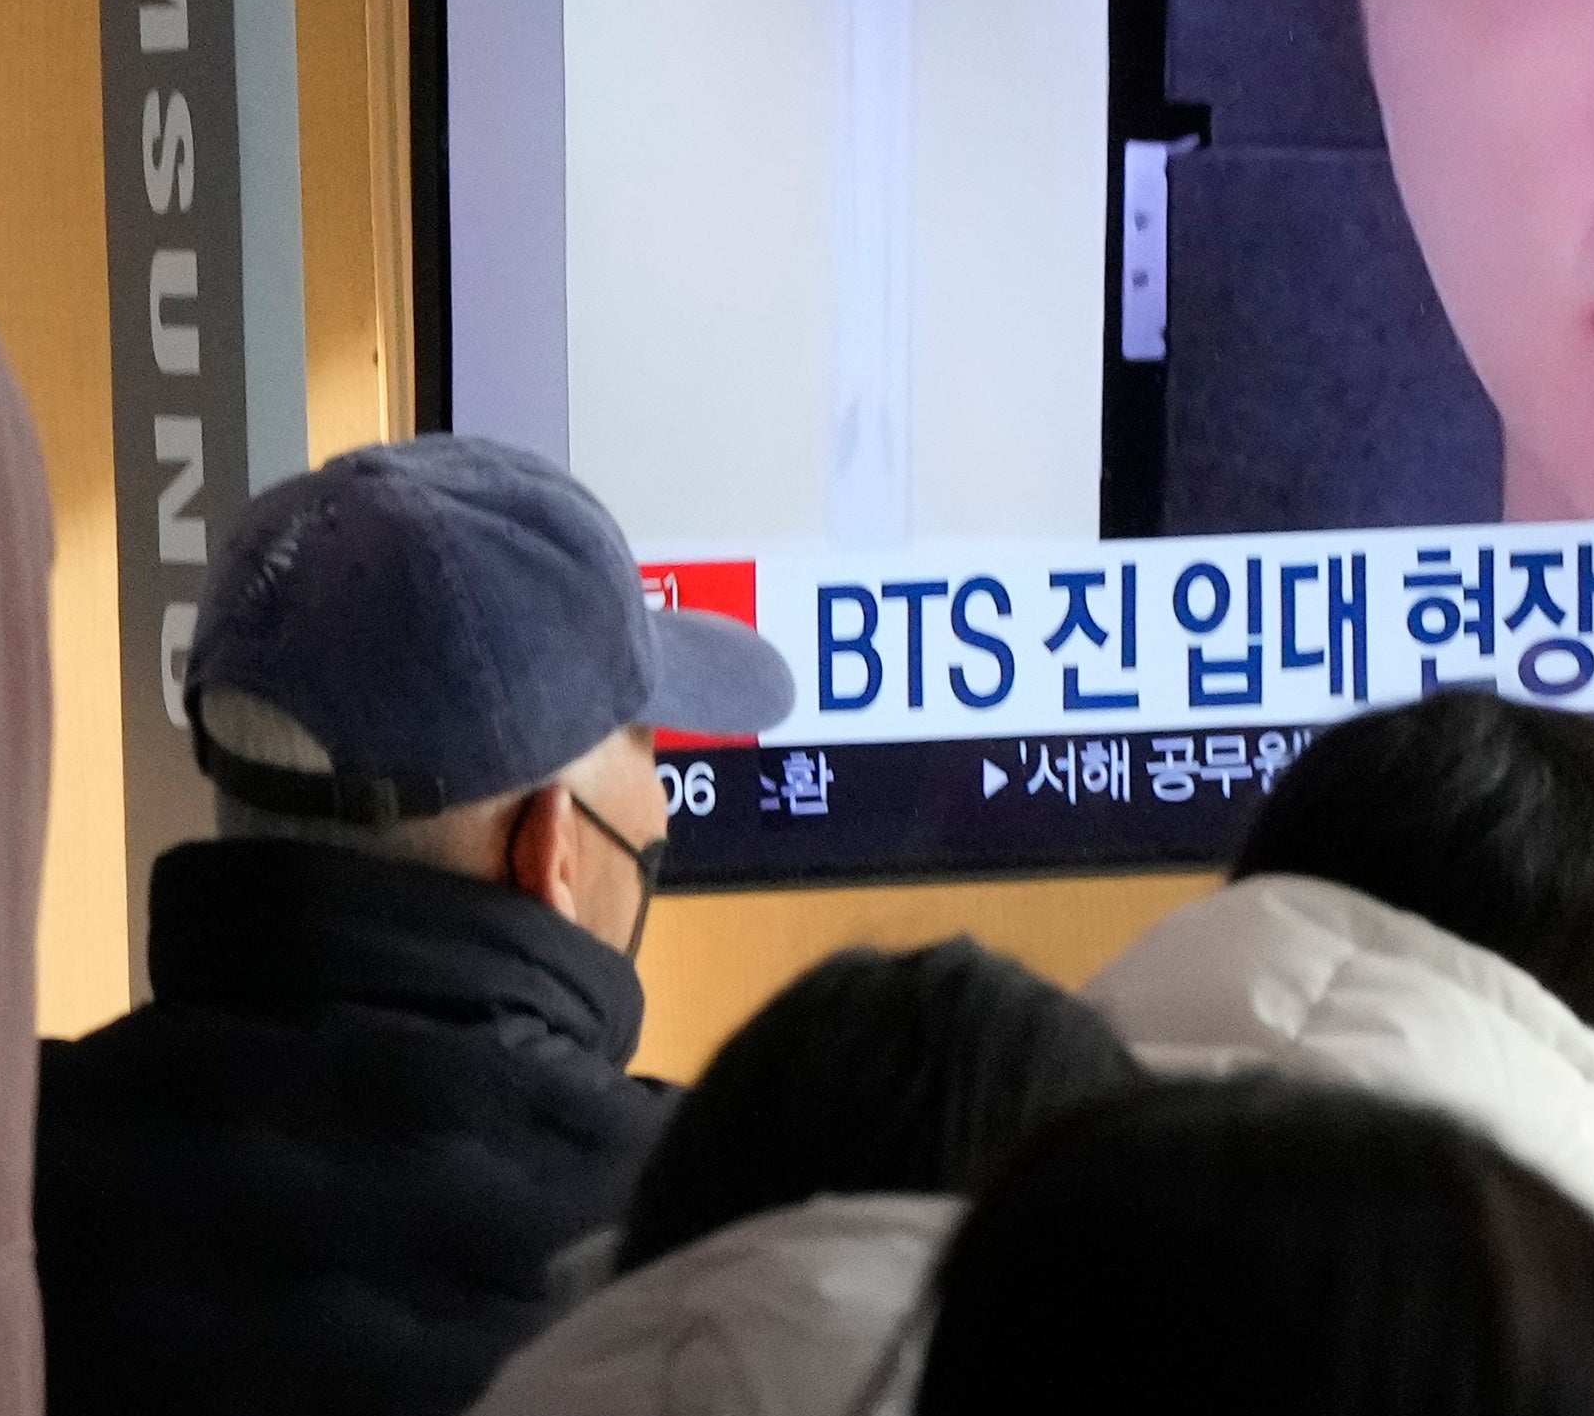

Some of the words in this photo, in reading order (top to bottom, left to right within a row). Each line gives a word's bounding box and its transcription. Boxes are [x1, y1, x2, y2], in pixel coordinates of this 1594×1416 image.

[817, 575, 1016, 714] BTS
[1043, 562, 1140, 712] 진
[1172, 550, 1369, 705] 입대
